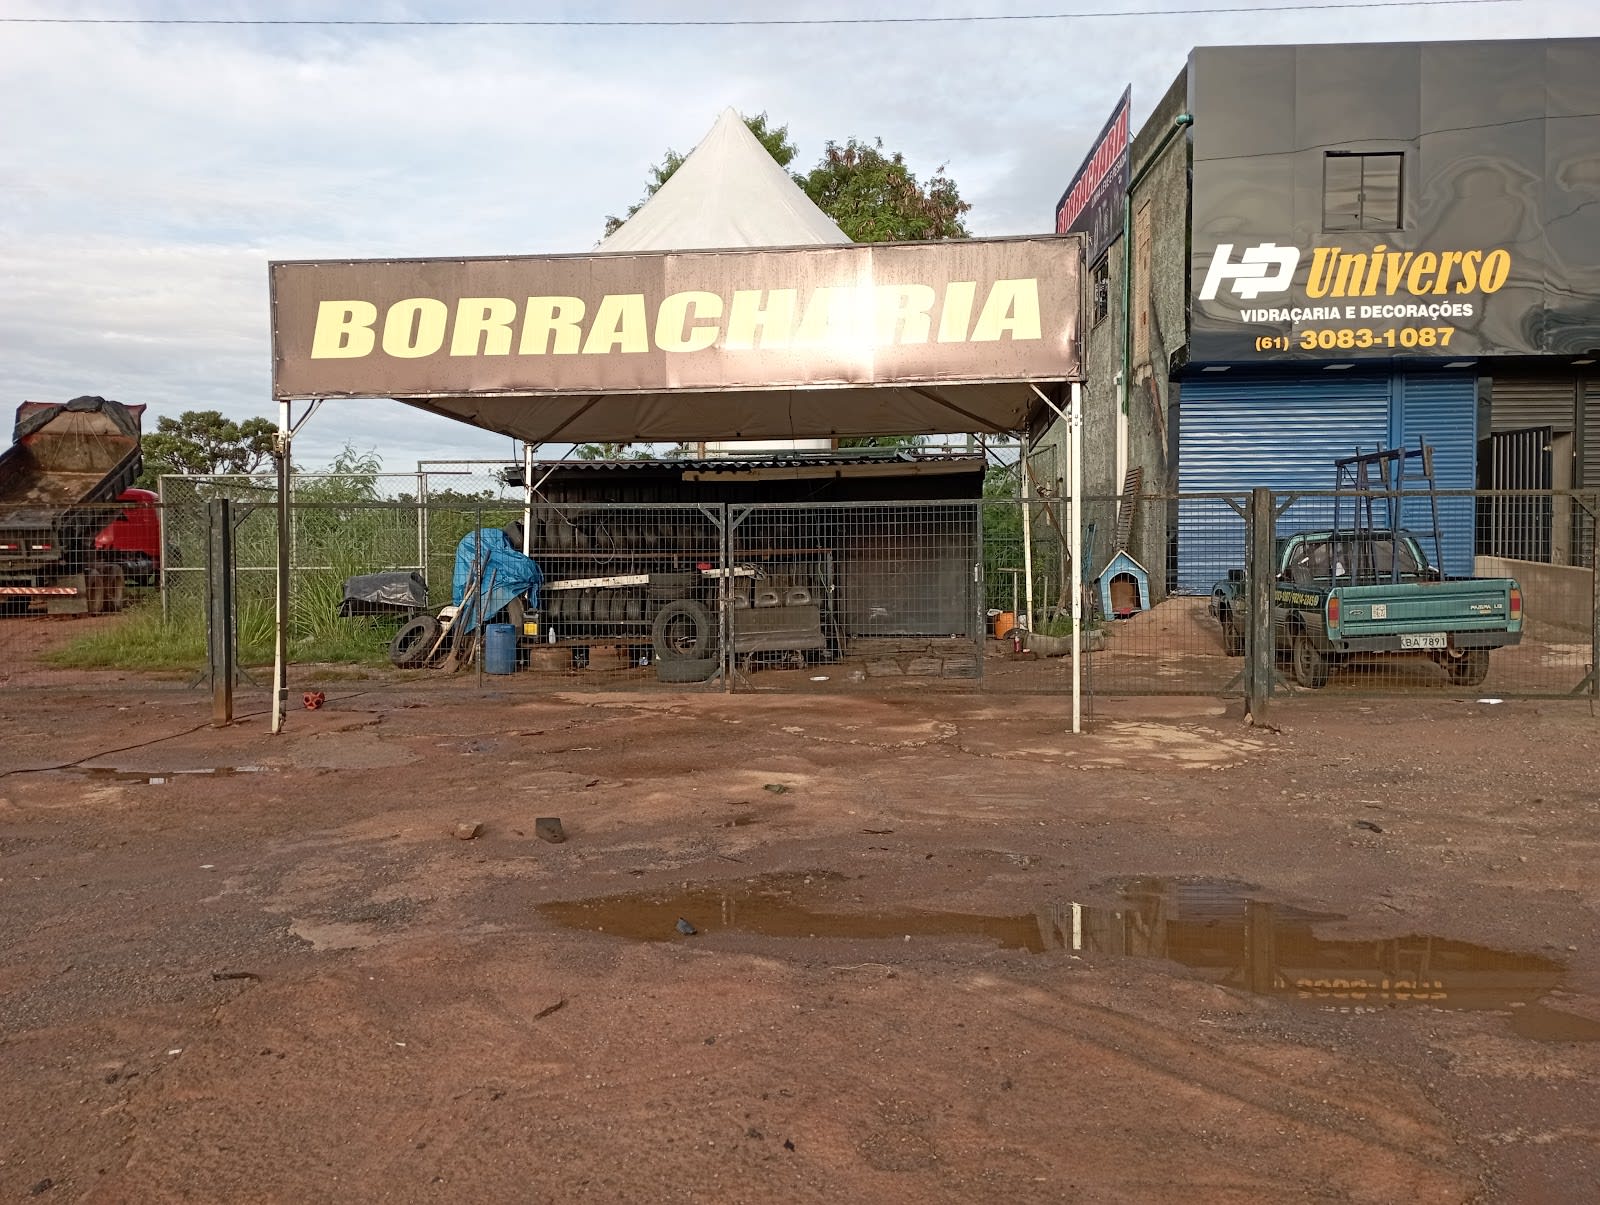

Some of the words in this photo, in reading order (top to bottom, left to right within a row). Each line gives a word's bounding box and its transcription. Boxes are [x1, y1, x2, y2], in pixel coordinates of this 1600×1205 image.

[1057, 102, 1127, 233] BORRACHARIA
[1305, 244, 1511, 298] Universo
[310, 277, 1042, 360] BORRACHARIA
[1240, 303, 1341, 325] VIDRAÇARIA
[1345, 305, 1356, 319] E
[1360, 300, 1473, 320] DECORAÇÕES
[1255, 335, 1290, 351] (61)
[1300, 326, 1455, 350] 3083-1087
[1422, 637, 1446, 647] 7891
